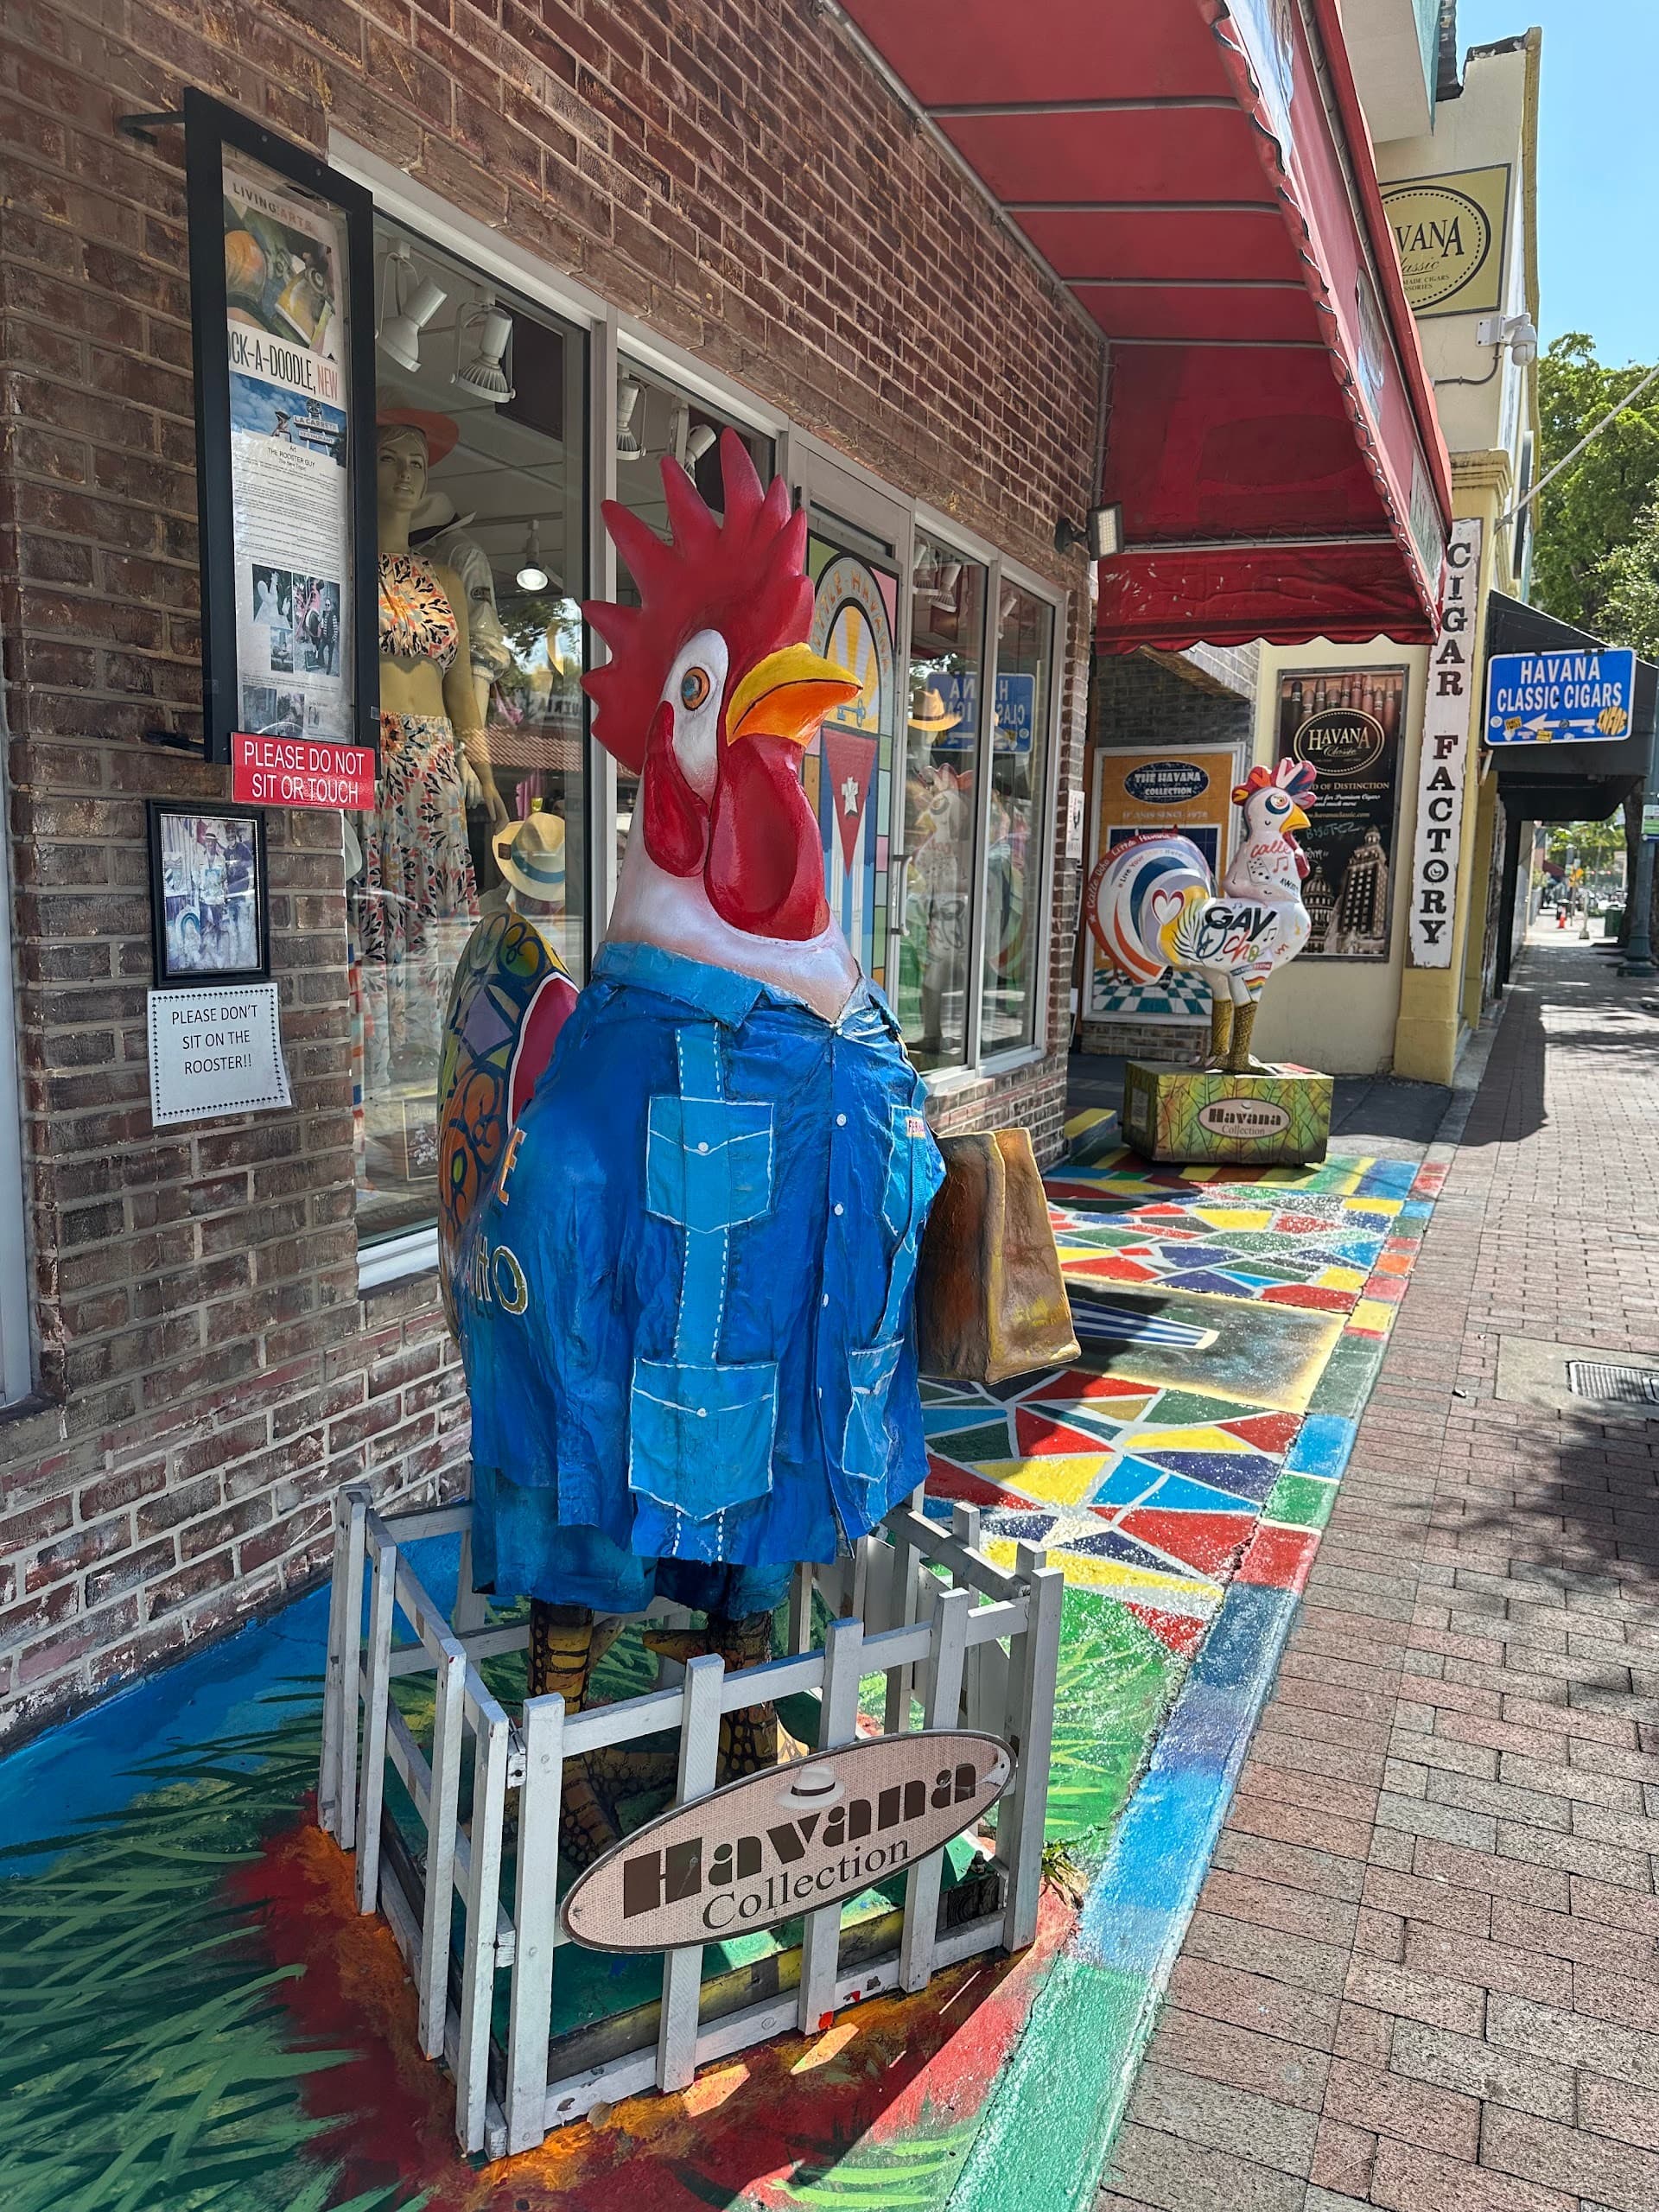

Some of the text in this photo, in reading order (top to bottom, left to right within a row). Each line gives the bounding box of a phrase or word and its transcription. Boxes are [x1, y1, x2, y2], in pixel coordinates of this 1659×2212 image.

[233, 182, 276, 213] LIVING
[1395, 216, 1465, 257] VANA
[1400, 257, 1440, 274] lassic
[228, 331, 339, 401] CK-A-DOODLE, NEW
[1436, 541, 1471, 696] CIGAR
[1520, 656, 1600, 685] HAVANA
[1497, 682, 1622, 713] CLASSIC CIGARS
[1307, 726, 1371, 752] HAVANA
[244, 741, 365, 776] PLEASE DO NOT
[251, 772, 359, 804] SIT OR TOUCH
[1134, 772, 1201, 784] THE HAVANA
[1144, 787, 1192, 796] COLLECTION
[1419, 734, 1459, 944] FACTORY
[1205, 906, 1278, 942] GAY
[172, 1004, 258, 1026] PLEASE DON'T
[182, 1029, 251, 1050] SIT ON THE
[184, 1053, 251, 1075] ROOSTER!!
[1208, 1108, 1281, 1127] Havana
[1221, 1124, 1265, 1136] Collection
[623, 1762, 976, 1920] Havana
[702, 1834, 911, 1929] Collection
